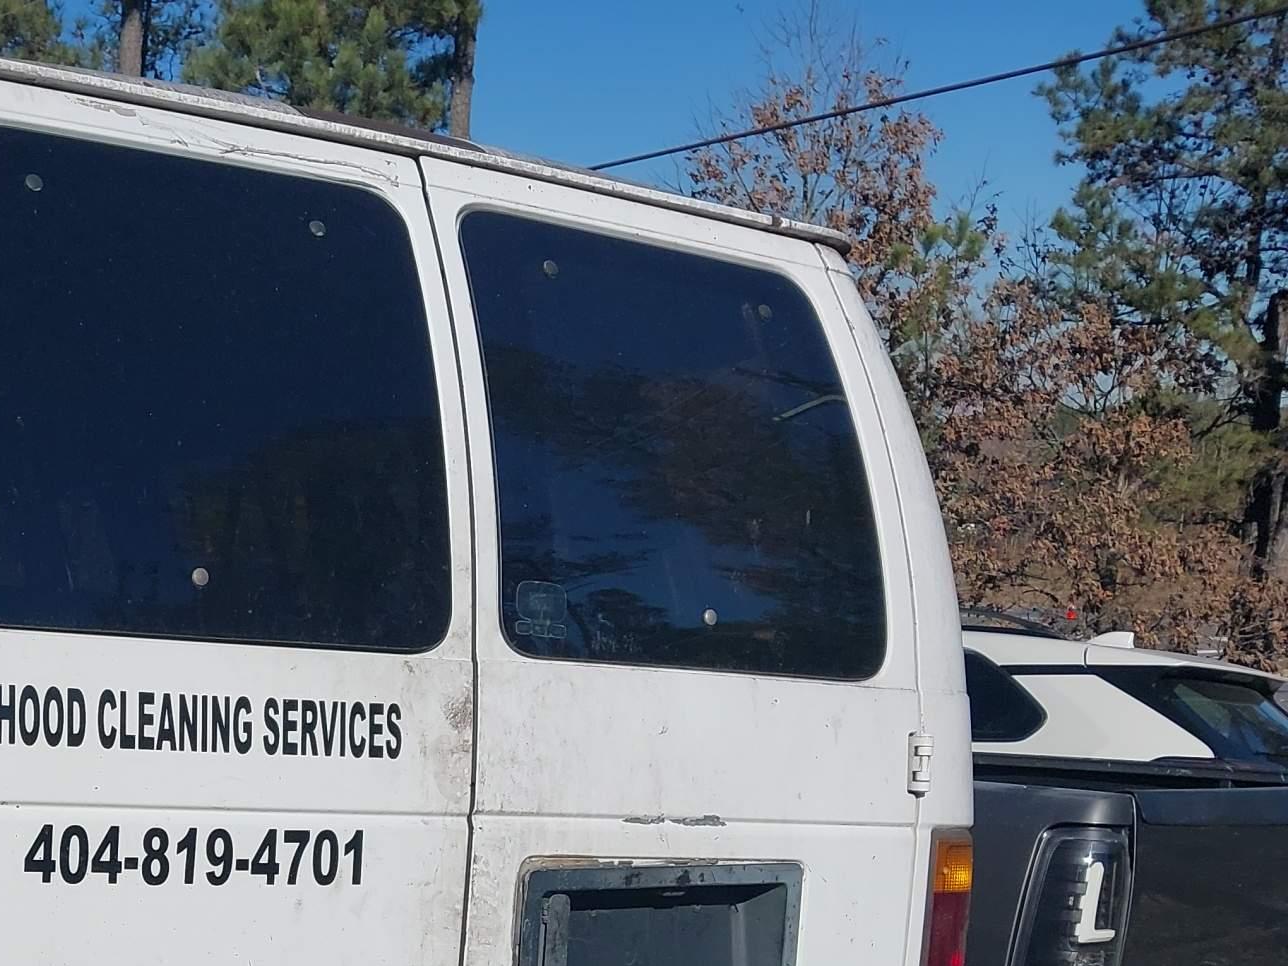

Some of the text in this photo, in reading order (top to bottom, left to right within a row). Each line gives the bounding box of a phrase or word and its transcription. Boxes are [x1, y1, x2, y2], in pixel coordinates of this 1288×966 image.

[98, 689, 253, 755] CLEANING
[263, 697, 402, 759] SERVICES
[23, 823, 364, 886] 404-819-4701
